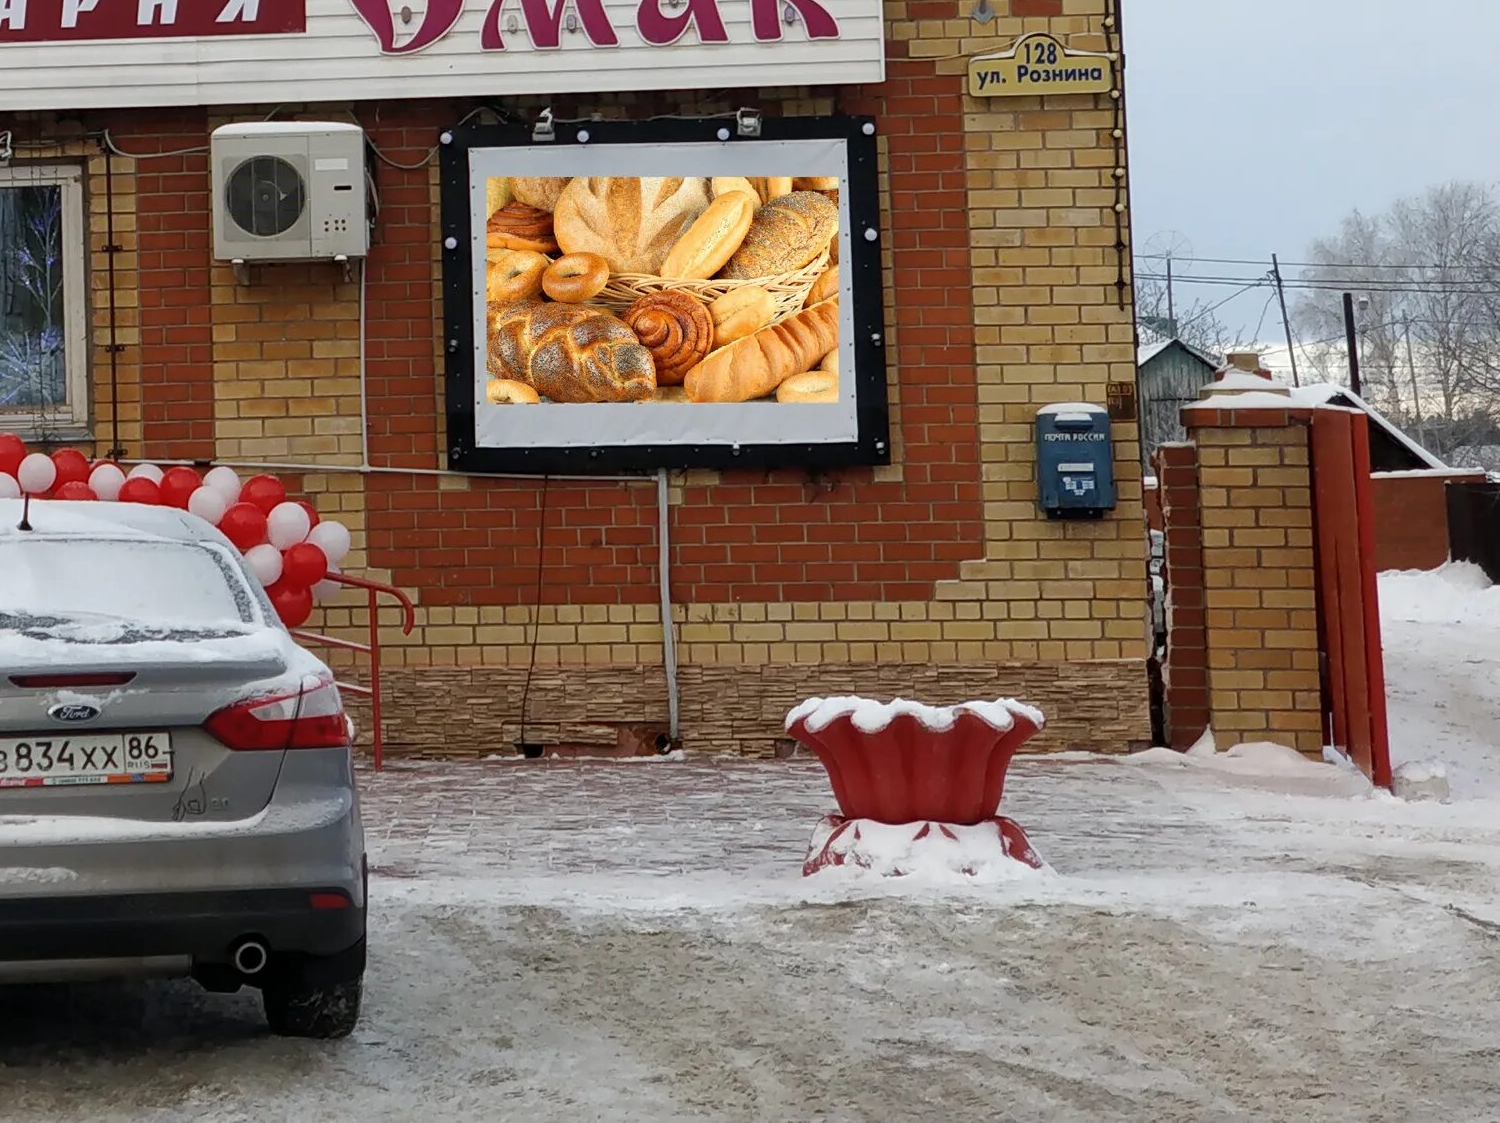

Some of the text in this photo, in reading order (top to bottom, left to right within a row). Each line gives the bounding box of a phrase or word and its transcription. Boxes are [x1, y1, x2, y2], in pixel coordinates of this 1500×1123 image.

[1024, 42, 1057, 65] 128
[977, 65, 1103, 90] ул. Рознина
[59, 705, 91, 719] Ford
[127, 735, 159, 760] 86
[127, 760, 150, 770] RUS
